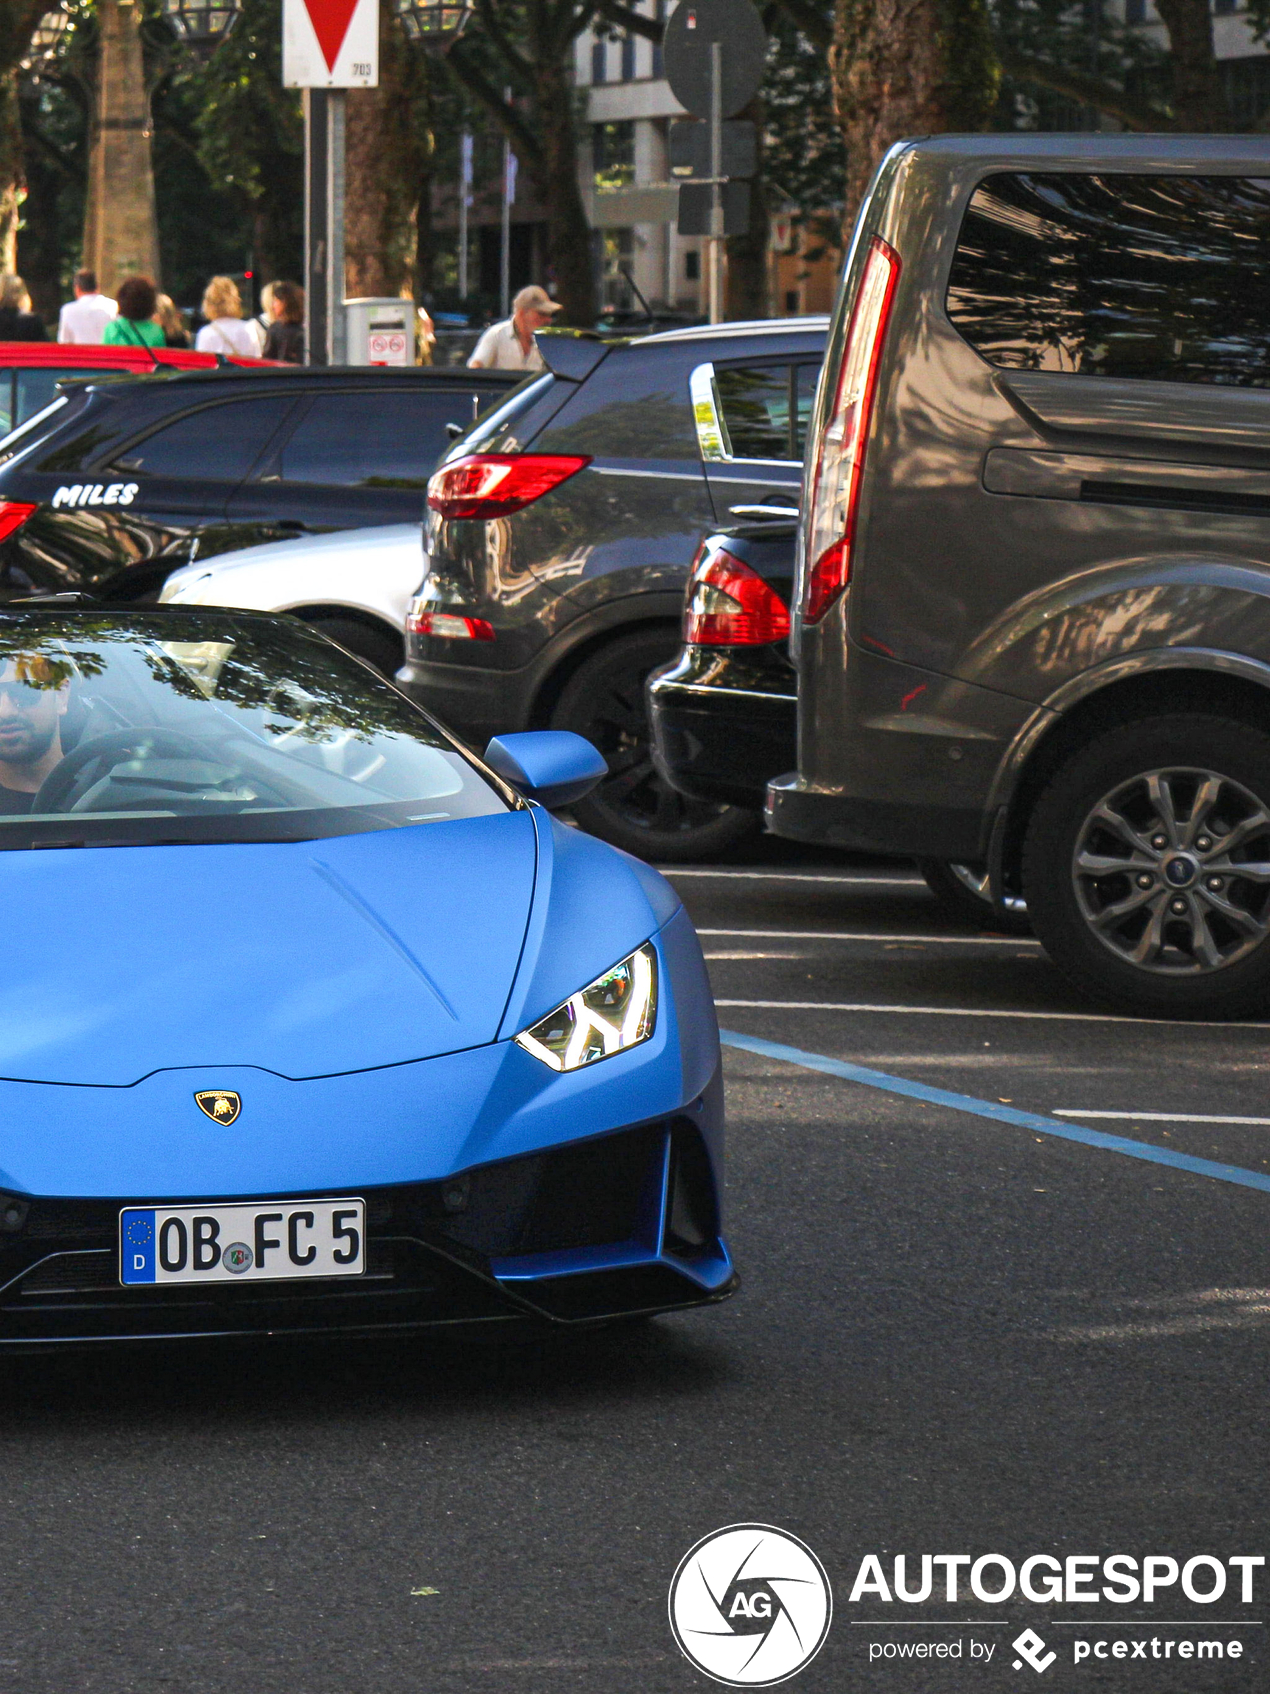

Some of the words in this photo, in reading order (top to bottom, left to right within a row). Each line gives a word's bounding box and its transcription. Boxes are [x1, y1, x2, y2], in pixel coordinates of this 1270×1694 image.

[353, 62, 372, 76] 703
[51, 482, 139, 509] MILES
[158, 1216, 222, 1273] OB
[254, 1211, 317, 1269] FC
[332, 1209, 360, 1265] 5
[133, 1254, 146, 1270] D
